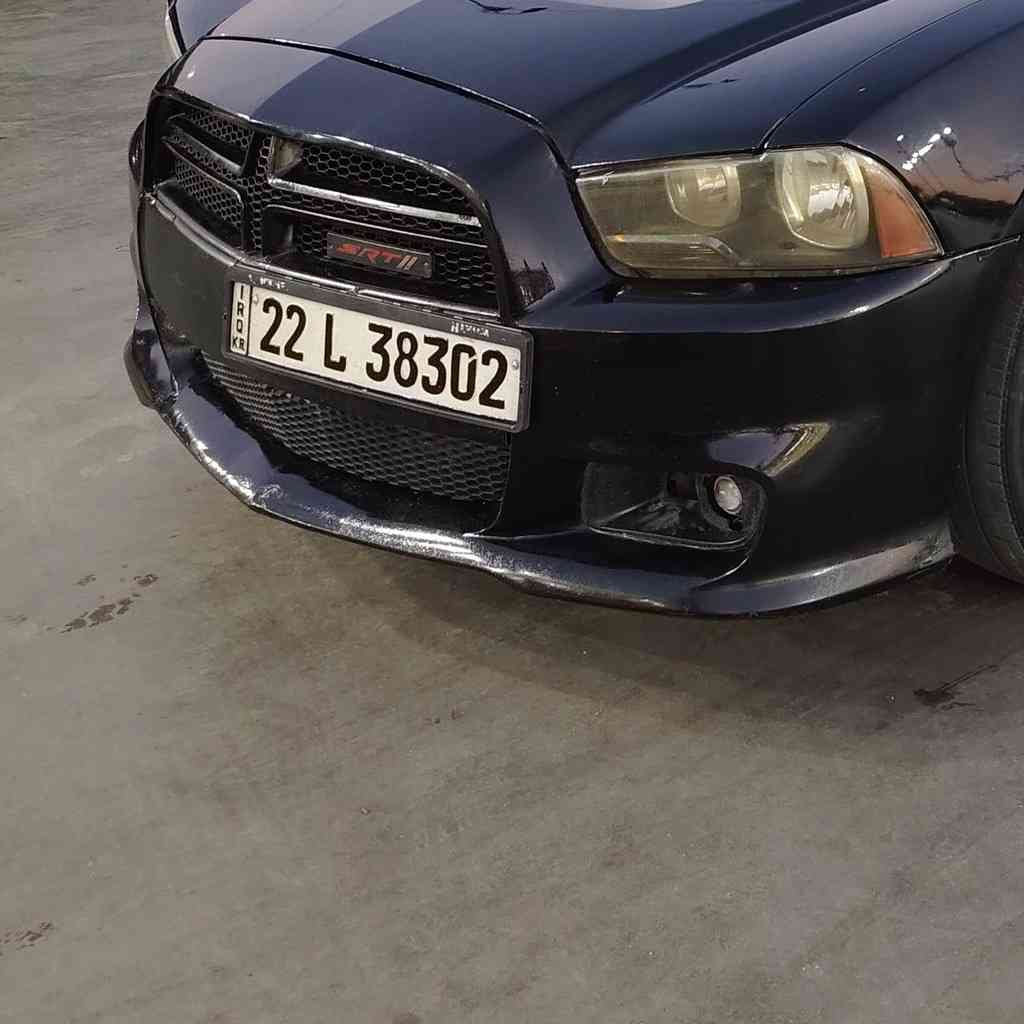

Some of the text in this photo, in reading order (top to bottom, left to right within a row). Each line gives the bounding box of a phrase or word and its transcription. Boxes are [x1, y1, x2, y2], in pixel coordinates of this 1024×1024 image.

[260, 297, 508, 410] 22 L 38302
